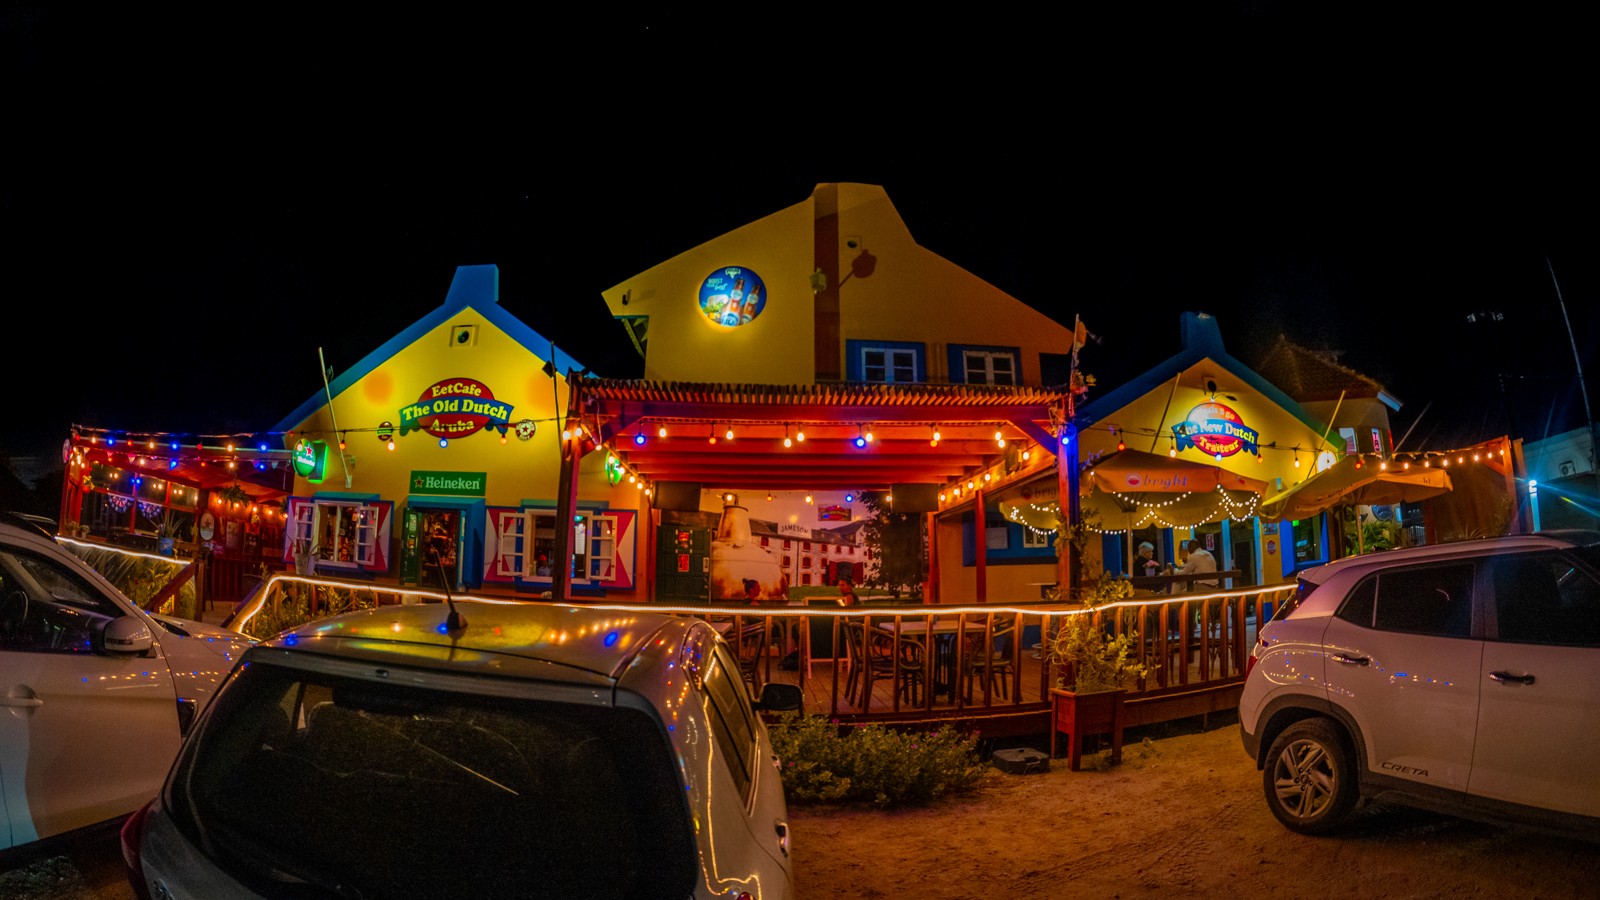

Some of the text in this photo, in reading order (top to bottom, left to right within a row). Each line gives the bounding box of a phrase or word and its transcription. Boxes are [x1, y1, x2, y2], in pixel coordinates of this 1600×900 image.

[432, 382, 482, 398] EetCafe
[403, 399, 508, 421] The Old Dutch
[430, 418, 475, 433] Aruba
[1200, 420, 1224, 433] New
[1225, 422, 1255, 444] Dutch
[1199, 436, 1239, 454] Traiteur
[425, 476, 480, 490] Heineken
[1144, 473, 1188, 487] bright
[1034, 487, 1060, 500] brig
[781, 524, 809, 534] JAMESON
[1381, 761, 1429, 777] CRETA
